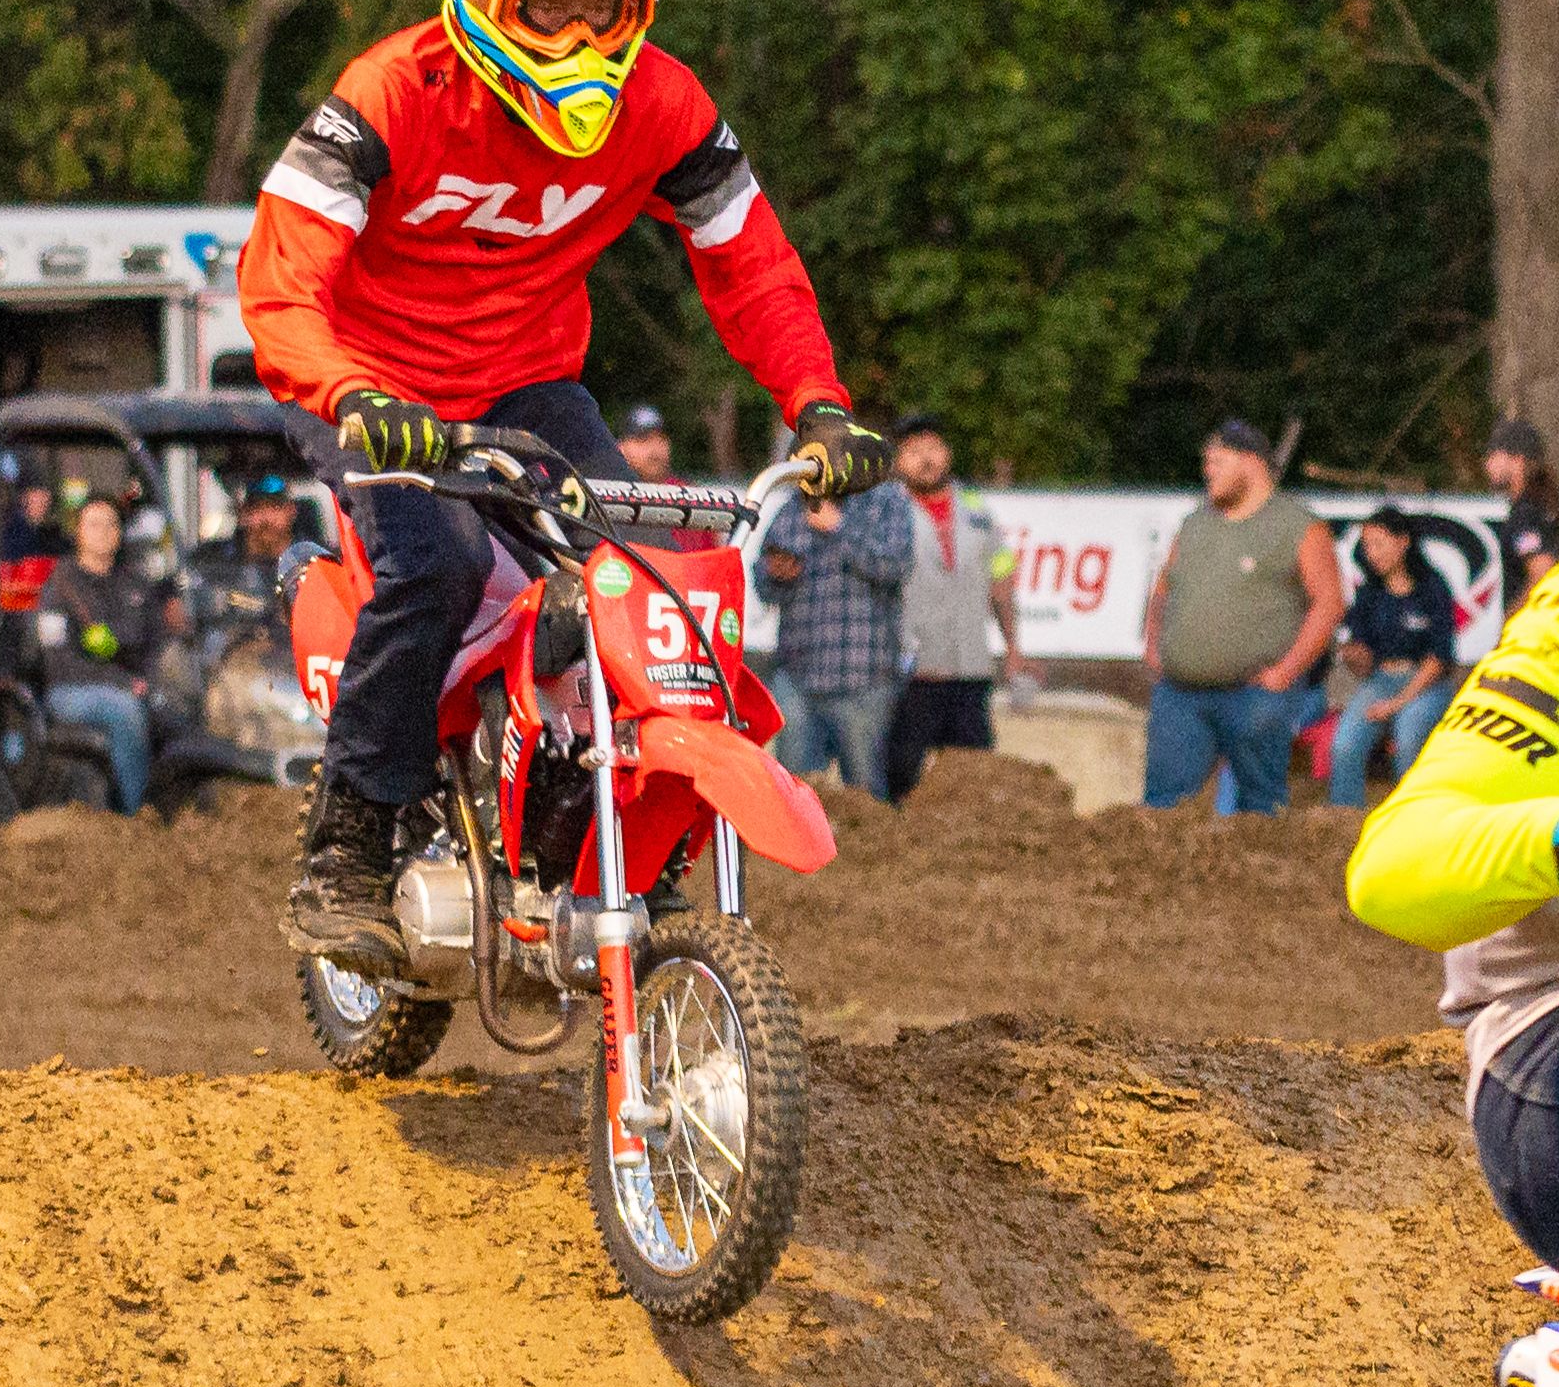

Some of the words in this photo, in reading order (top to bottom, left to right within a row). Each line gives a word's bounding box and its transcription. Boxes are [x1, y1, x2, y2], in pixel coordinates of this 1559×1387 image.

[402, 174, 607, 238] FLY
[647, 590, 721, 661] 57
[306, 655, 345, 719] 5
[659, 694, 715, 707] HONDA
